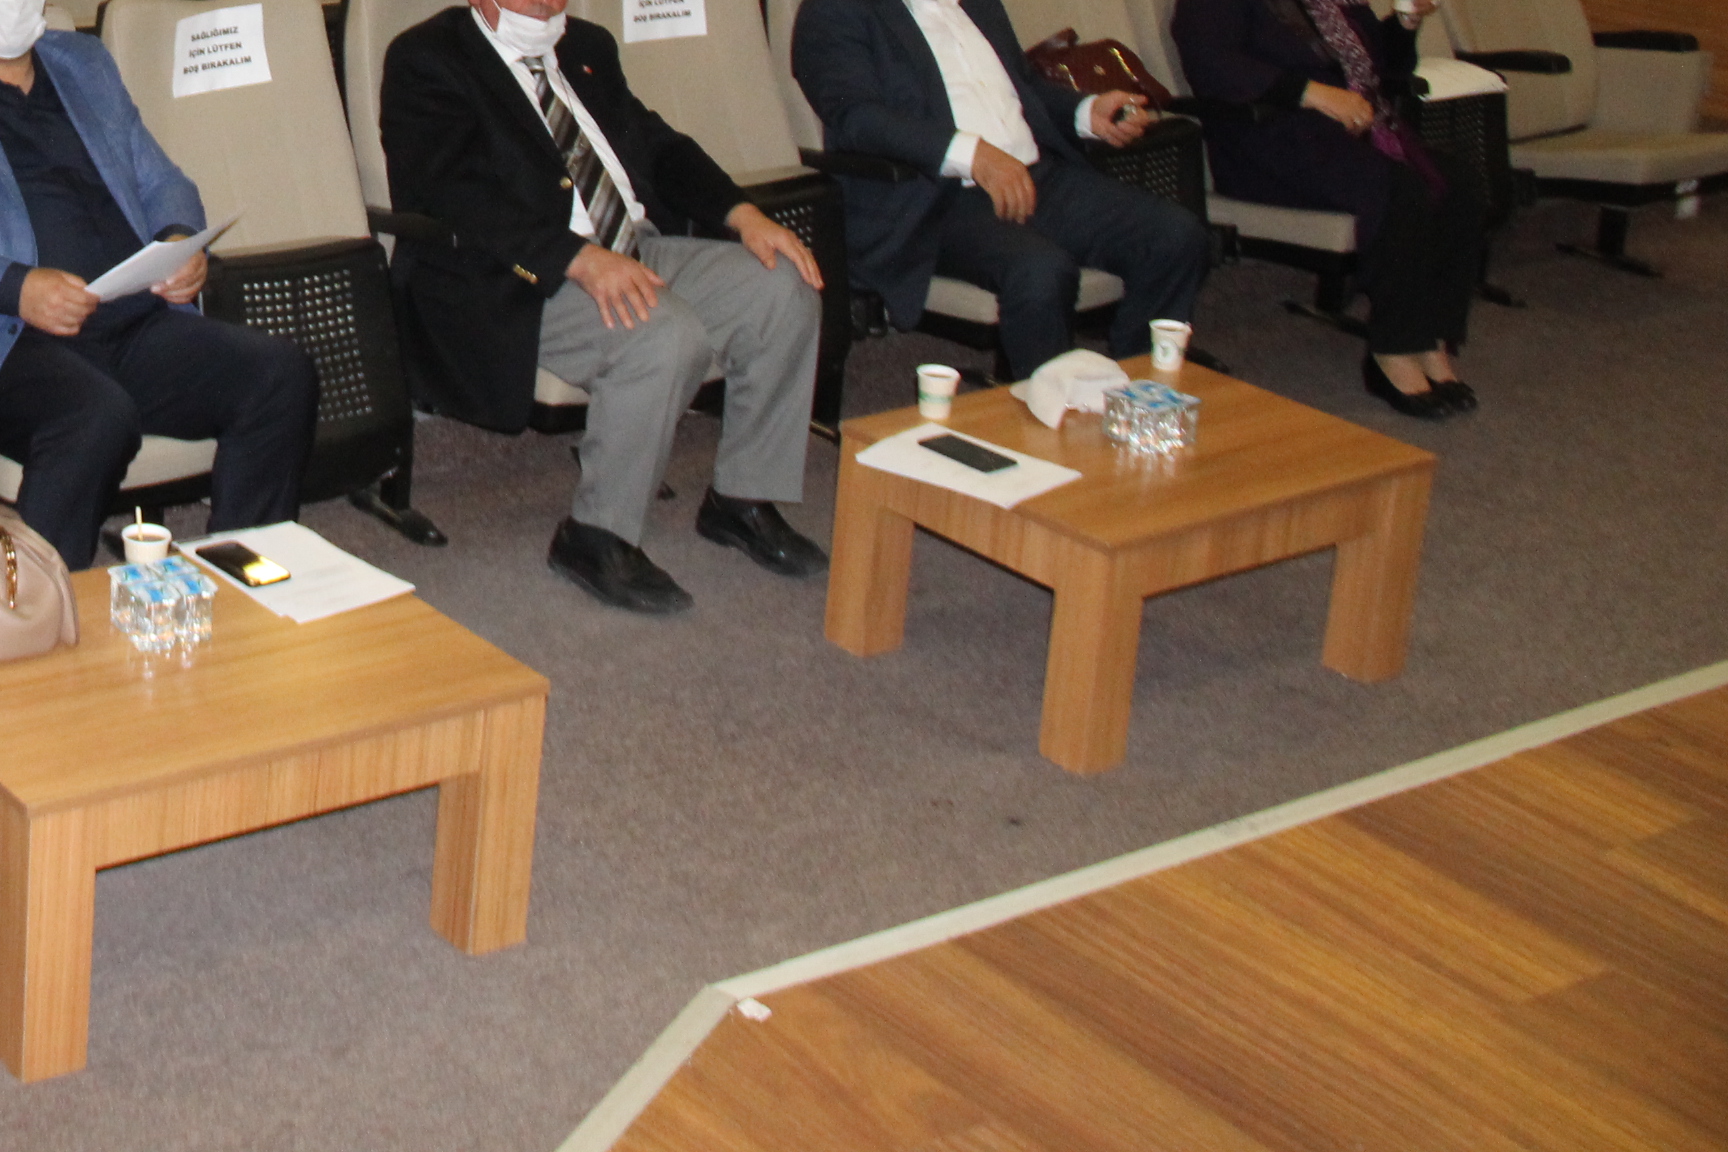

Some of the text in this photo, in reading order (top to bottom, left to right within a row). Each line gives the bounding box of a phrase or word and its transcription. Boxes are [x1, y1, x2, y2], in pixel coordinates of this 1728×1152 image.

[633, 9, 691, 23] BOŞ BIRAKALIM
[191, 26, 239, 41] SAĞLIĞIMIZ
[189, 41, 242, 59] İÇİN LÜTFEN
[183, 55, 252, 75] BOŞ BIRAKALIM
